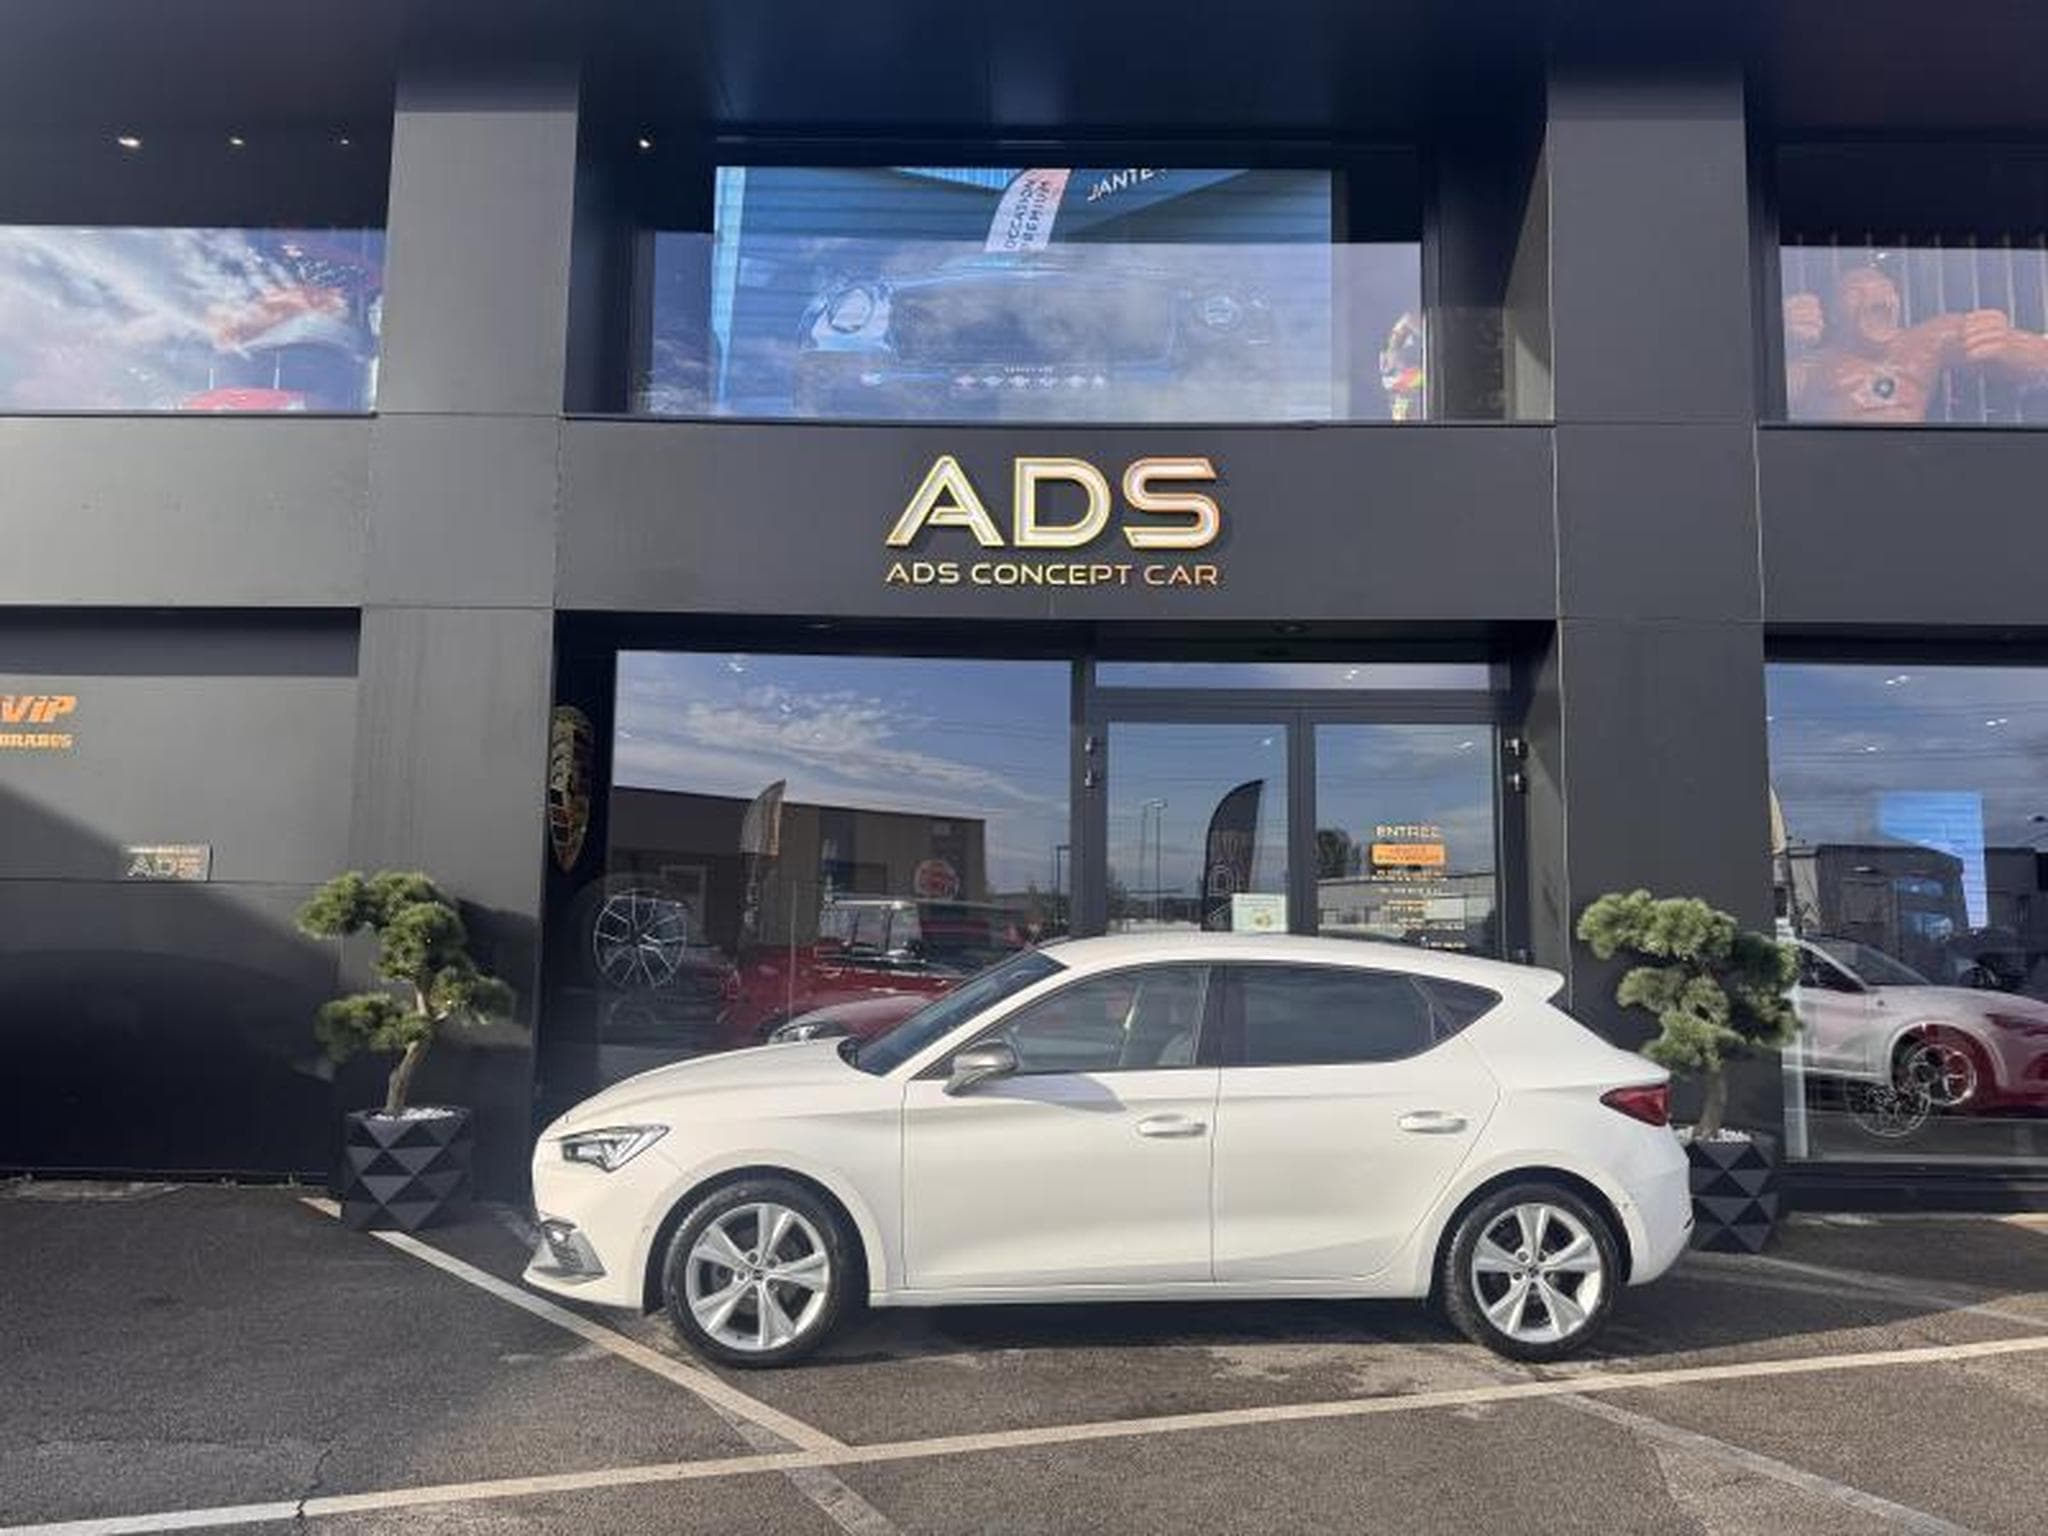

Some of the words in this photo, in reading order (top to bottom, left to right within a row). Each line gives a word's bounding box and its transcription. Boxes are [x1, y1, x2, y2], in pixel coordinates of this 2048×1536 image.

[1020, 180, 1049, 249] REMIUM
[886, 455, 1220, 548] ADS
[886, 563, 960, 584] ADS
[971, 564, 1132, 585] CONCEPT
[1144, 565, 1218, 585] CAR
